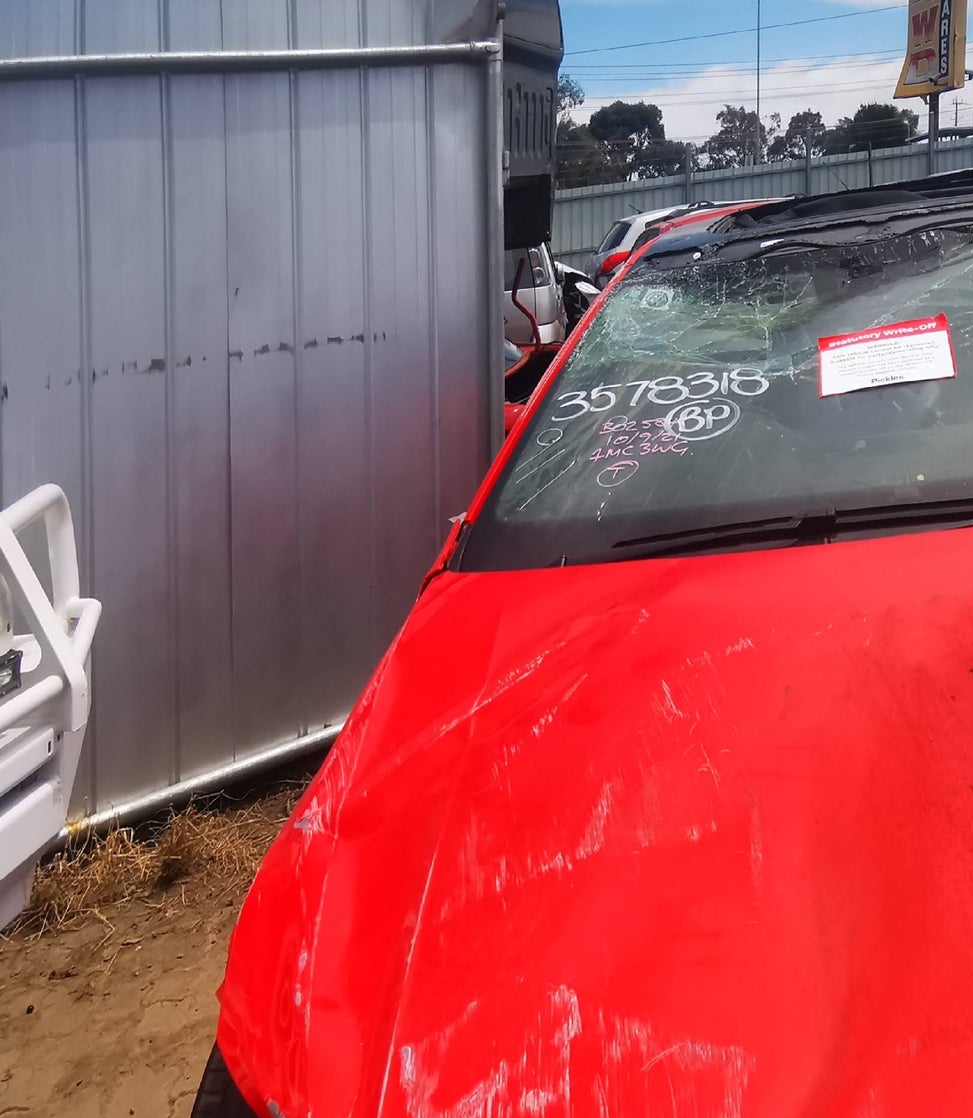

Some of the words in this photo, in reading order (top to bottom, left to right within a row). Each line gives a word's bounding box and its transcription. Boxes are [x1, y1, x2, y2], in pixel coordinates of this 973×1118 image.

[828, 331, 881, 348] Statutory
[883, 321, 937, 336] Write-Off
[871, 374, 905, 384] Pickles
[551, 368, 769, 422] 3578318
[679, 404, 731, 432] BP
